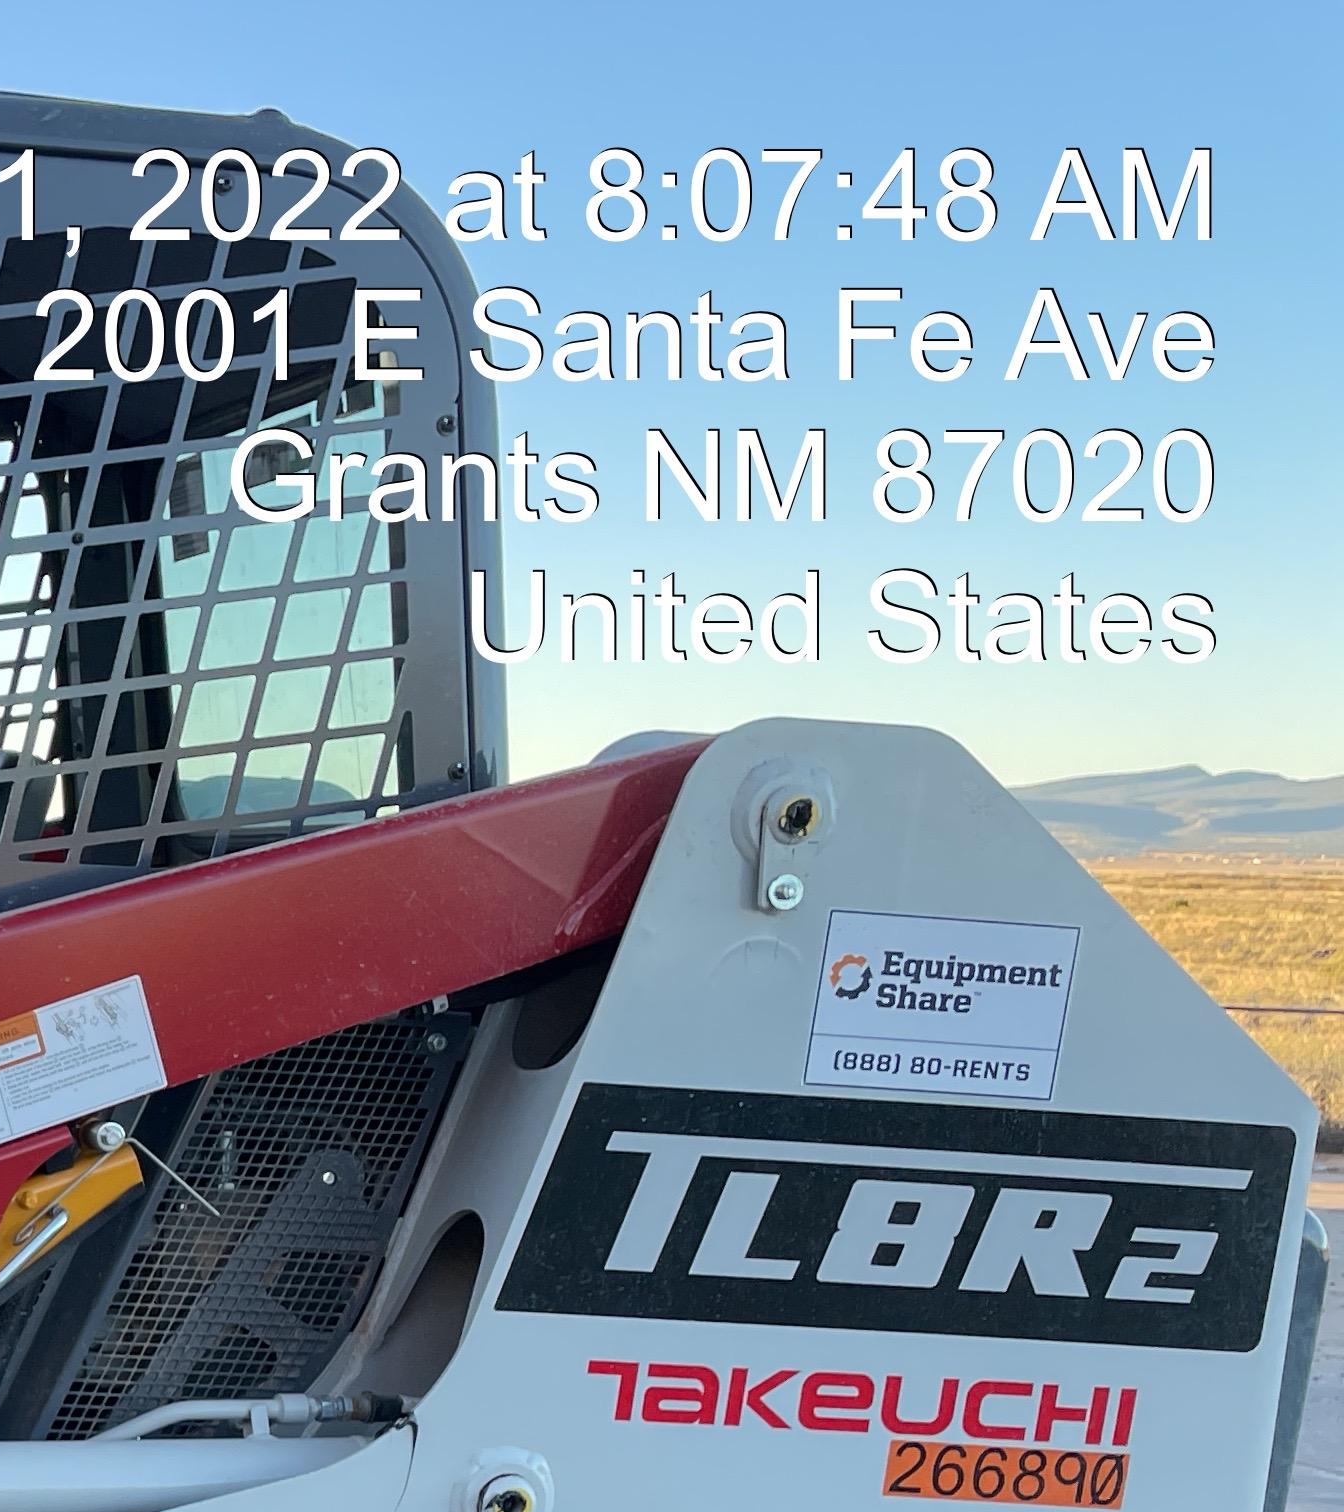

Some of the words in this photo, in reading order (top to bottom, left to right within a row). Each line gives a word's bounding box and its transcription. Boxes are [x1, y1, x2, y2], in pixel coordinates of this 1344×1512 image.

[879, 950, 1063, 990] Equipment
[875, 981, 974, 1015] Share
[833, 1049, 902, 1074] (888)
[910, 1055, 1031, 1083] 80-RENTS
[602, 1130, 1255, 1305] TL8R2
[587, 1360, 1139, 1446] TAKEUCHI
[888, 1442, 1126, 1506] 266890
